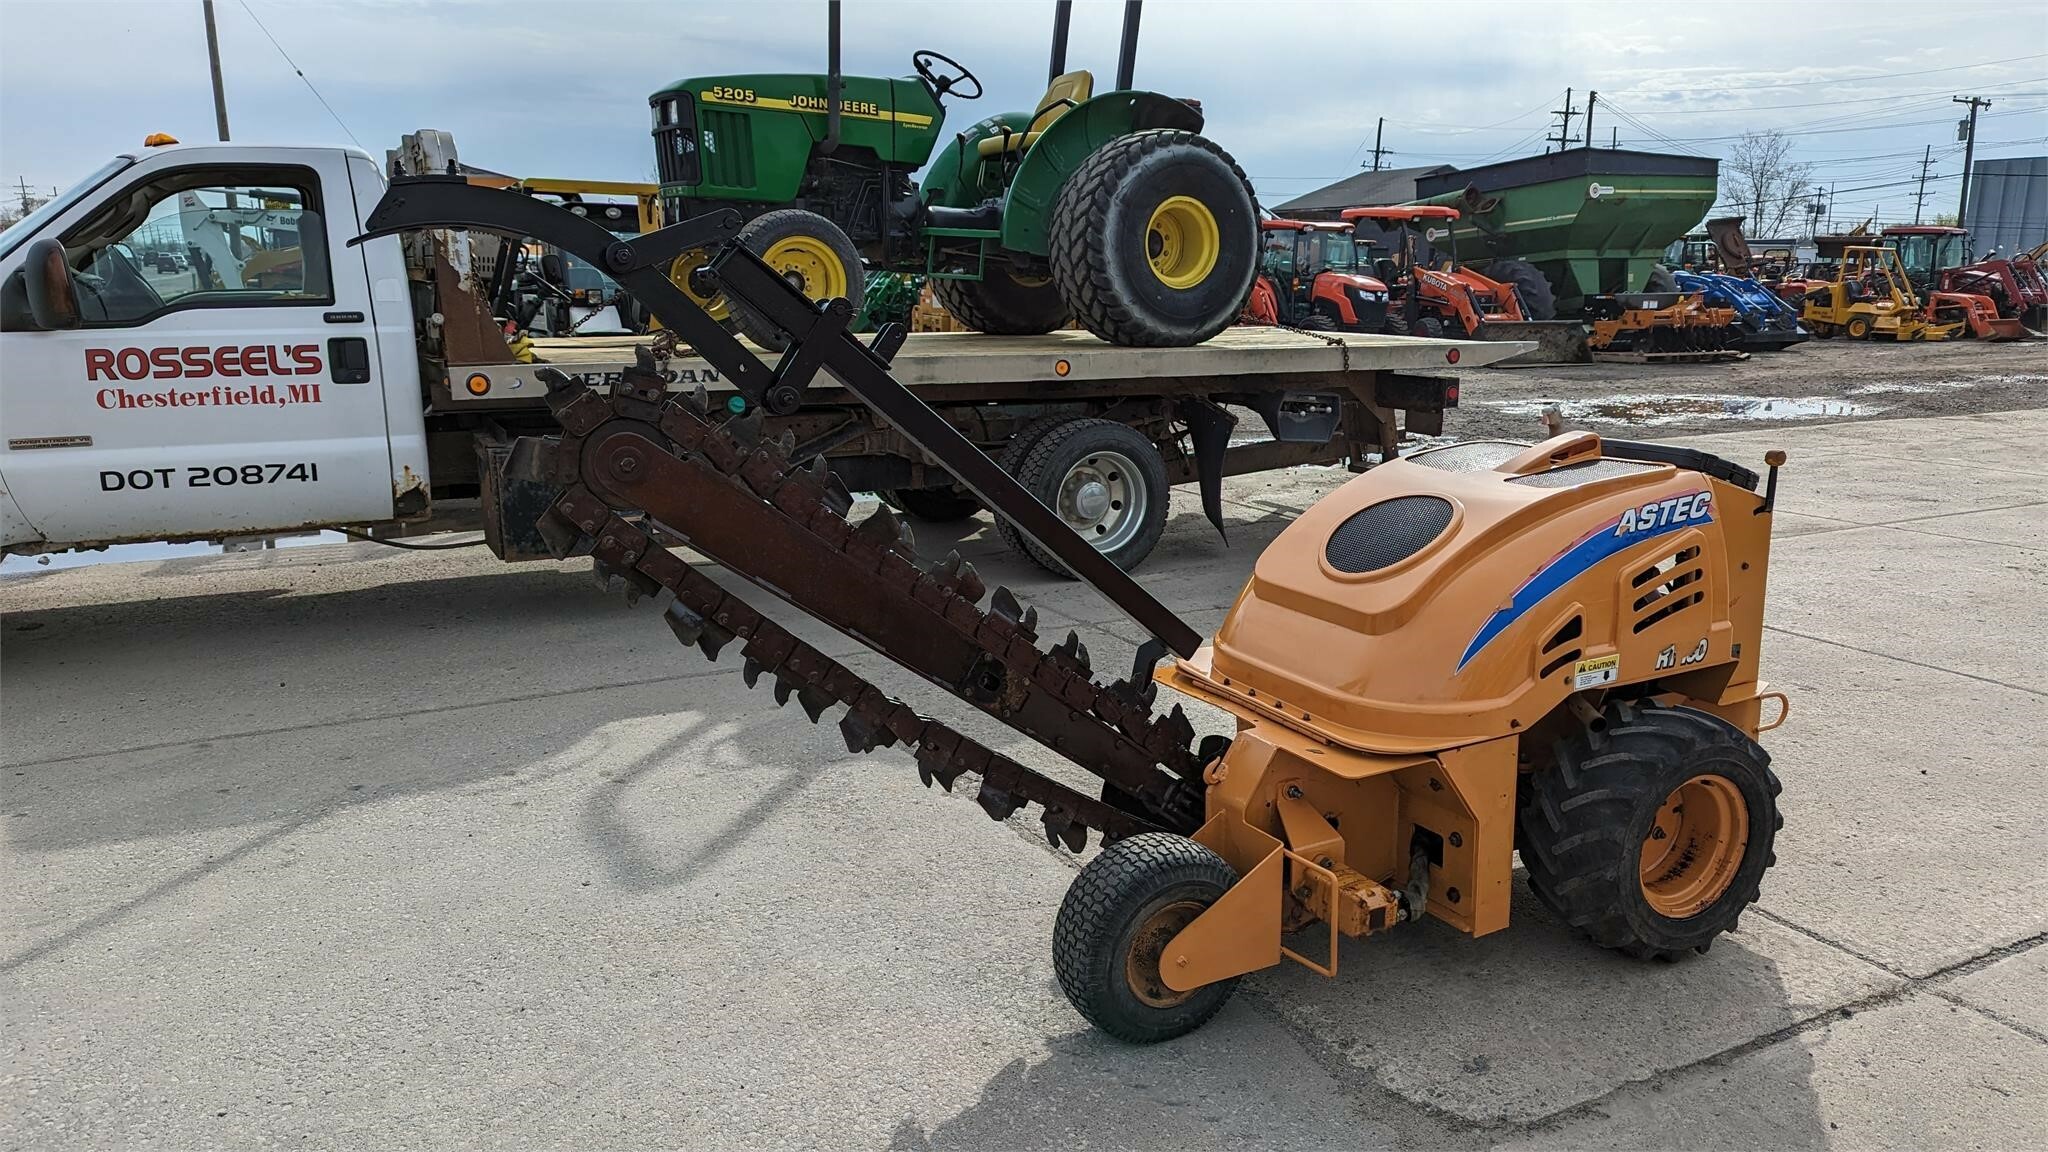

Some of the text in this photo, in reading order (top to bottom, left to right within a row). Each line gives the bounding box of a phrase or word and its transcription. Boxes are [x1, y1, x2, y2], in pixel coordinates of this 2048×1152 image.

[713, 86, 755, 101] 5205
[789, 95, 828, 109] JOHN
[1423, 274, 1447, 290] KUBOTA
[85, 345, 323, 381] ROSSEEL'S
[100, 463, 318, 492] DOT 208741
[1614, 490, 1712, 537] ASTEC
[1588, 659, 1617, 672] CAUTION
